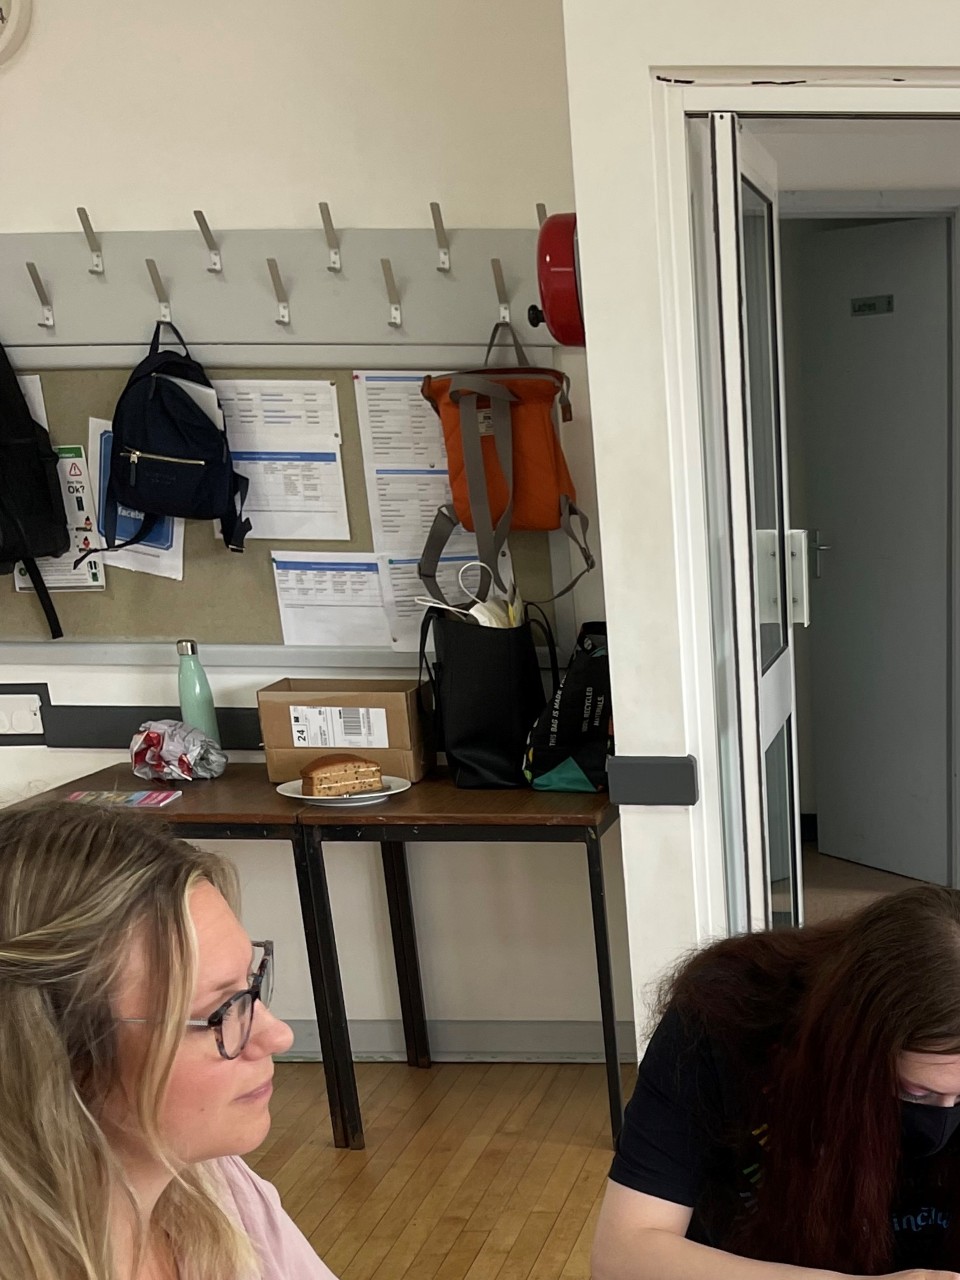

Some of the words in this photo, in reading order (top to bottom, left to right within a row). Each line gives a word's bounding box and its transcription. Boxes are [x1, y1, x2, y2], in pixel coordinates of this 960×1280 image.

[68, 485, 84, 493] Ok?
[584, 686, 593, 718] RECYCLED
[297, 730, 306, 742] 24
